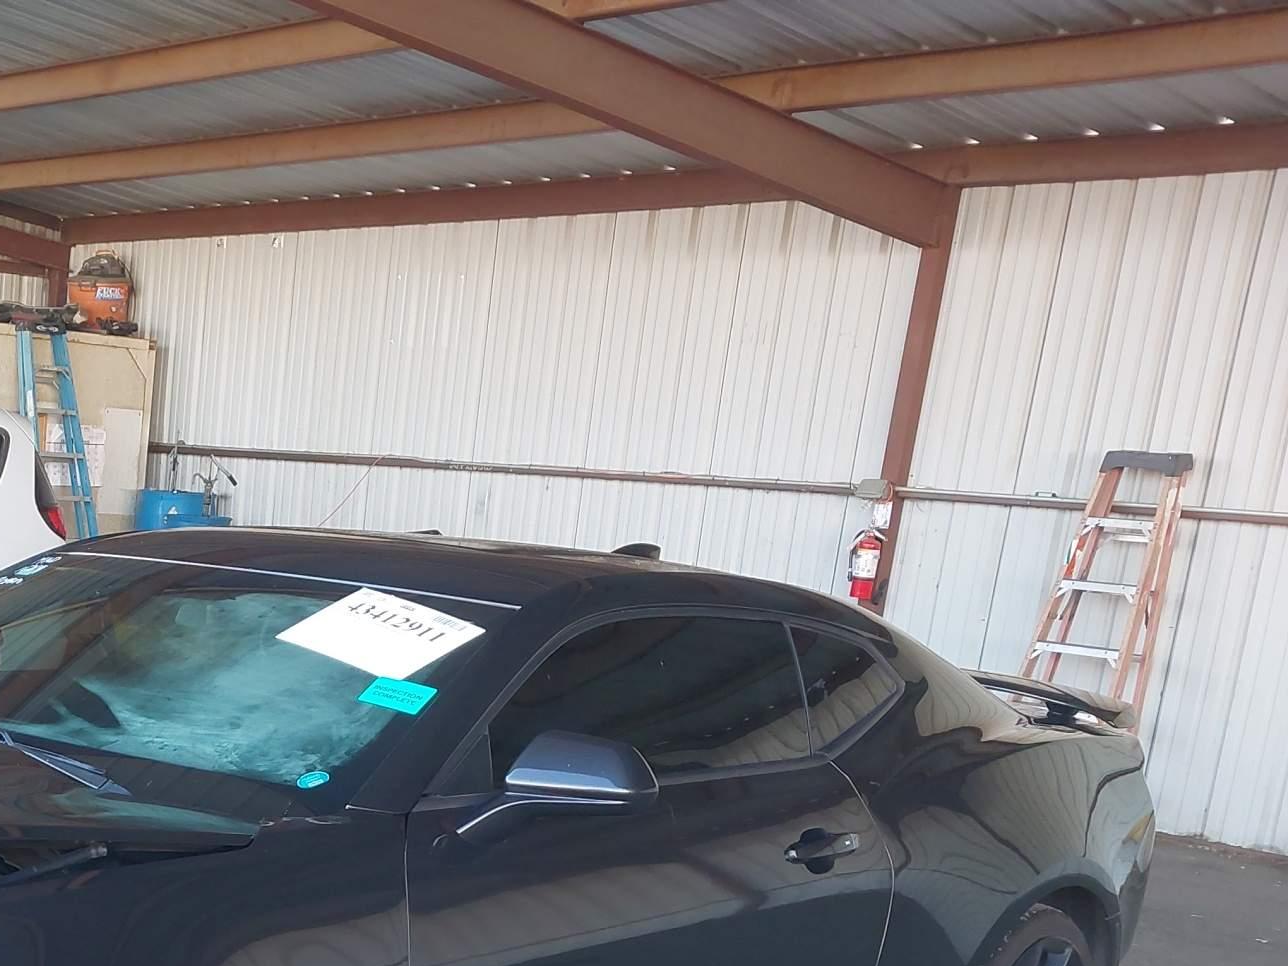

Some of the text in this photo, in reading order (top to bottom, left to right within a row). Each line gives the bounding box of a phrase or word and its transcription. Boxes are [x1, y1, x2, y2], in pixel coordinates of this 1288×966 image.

[347, 602, 445, 642] 43412911
[372, 690, 417, 706] COMPLETE
[373, 684, 423, 701] INSPECTION
